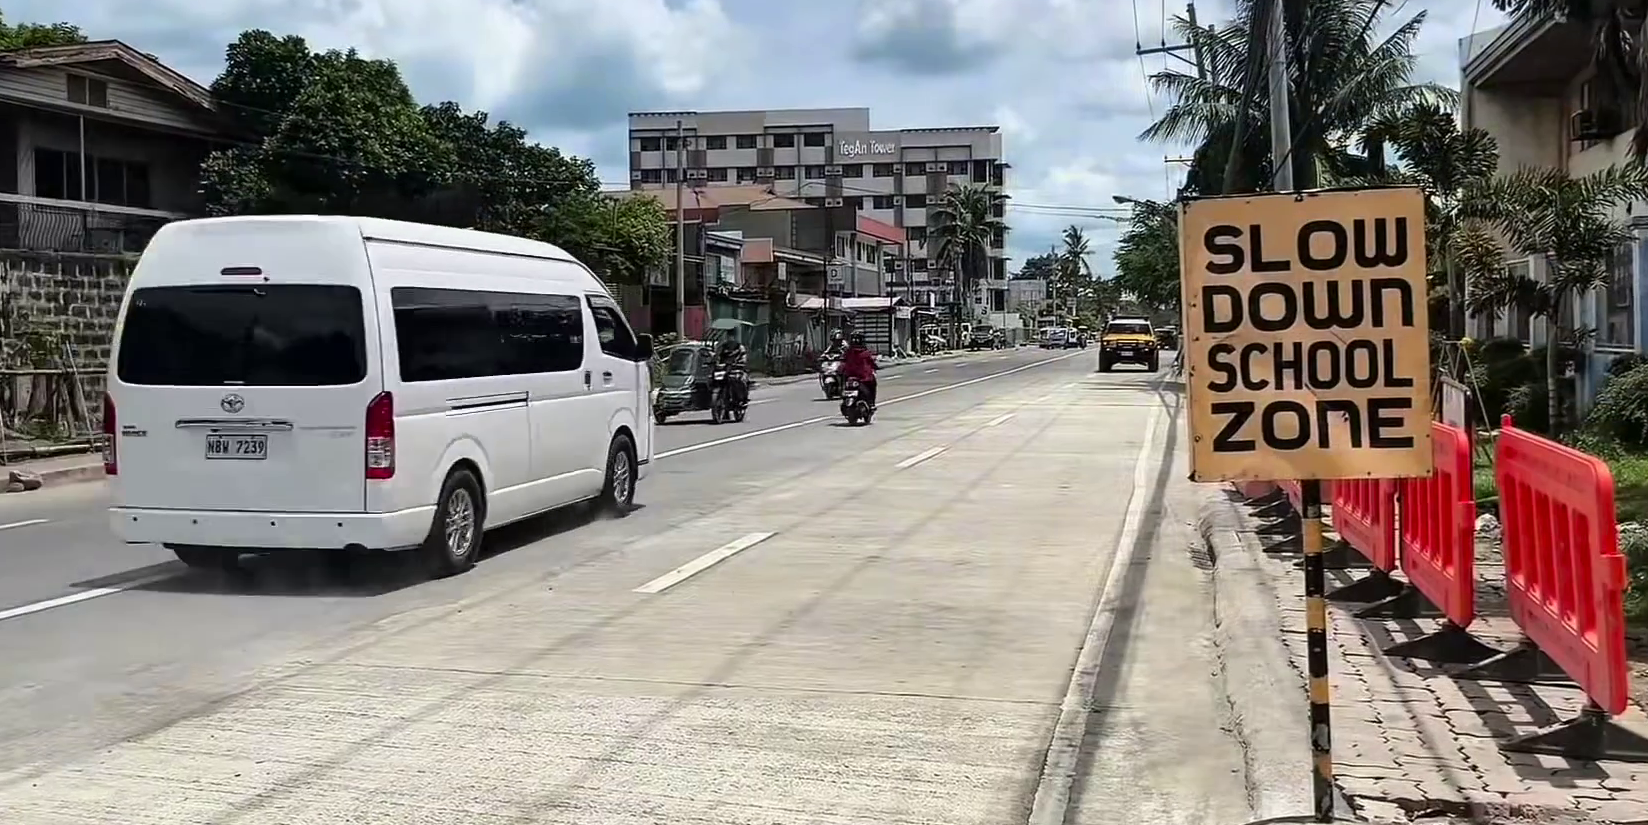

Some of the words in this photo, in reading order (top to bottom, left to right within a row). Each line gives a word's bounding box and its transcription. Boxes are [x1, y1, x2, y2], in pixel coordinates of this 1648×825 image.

[840, 140, 867, 157] TegAn
[870, 139, 896, 154] Tower
[1203, 217, 1408, 274] SLOW
[1202, 277, 1415, 333] DOWN
[1207, 339, 1414, 393] SCHOOL
[207, 440, 230, 454] NBW
[236, 440, 265, 454] 7239
[1211, 397, 1415, 452] ZONE
